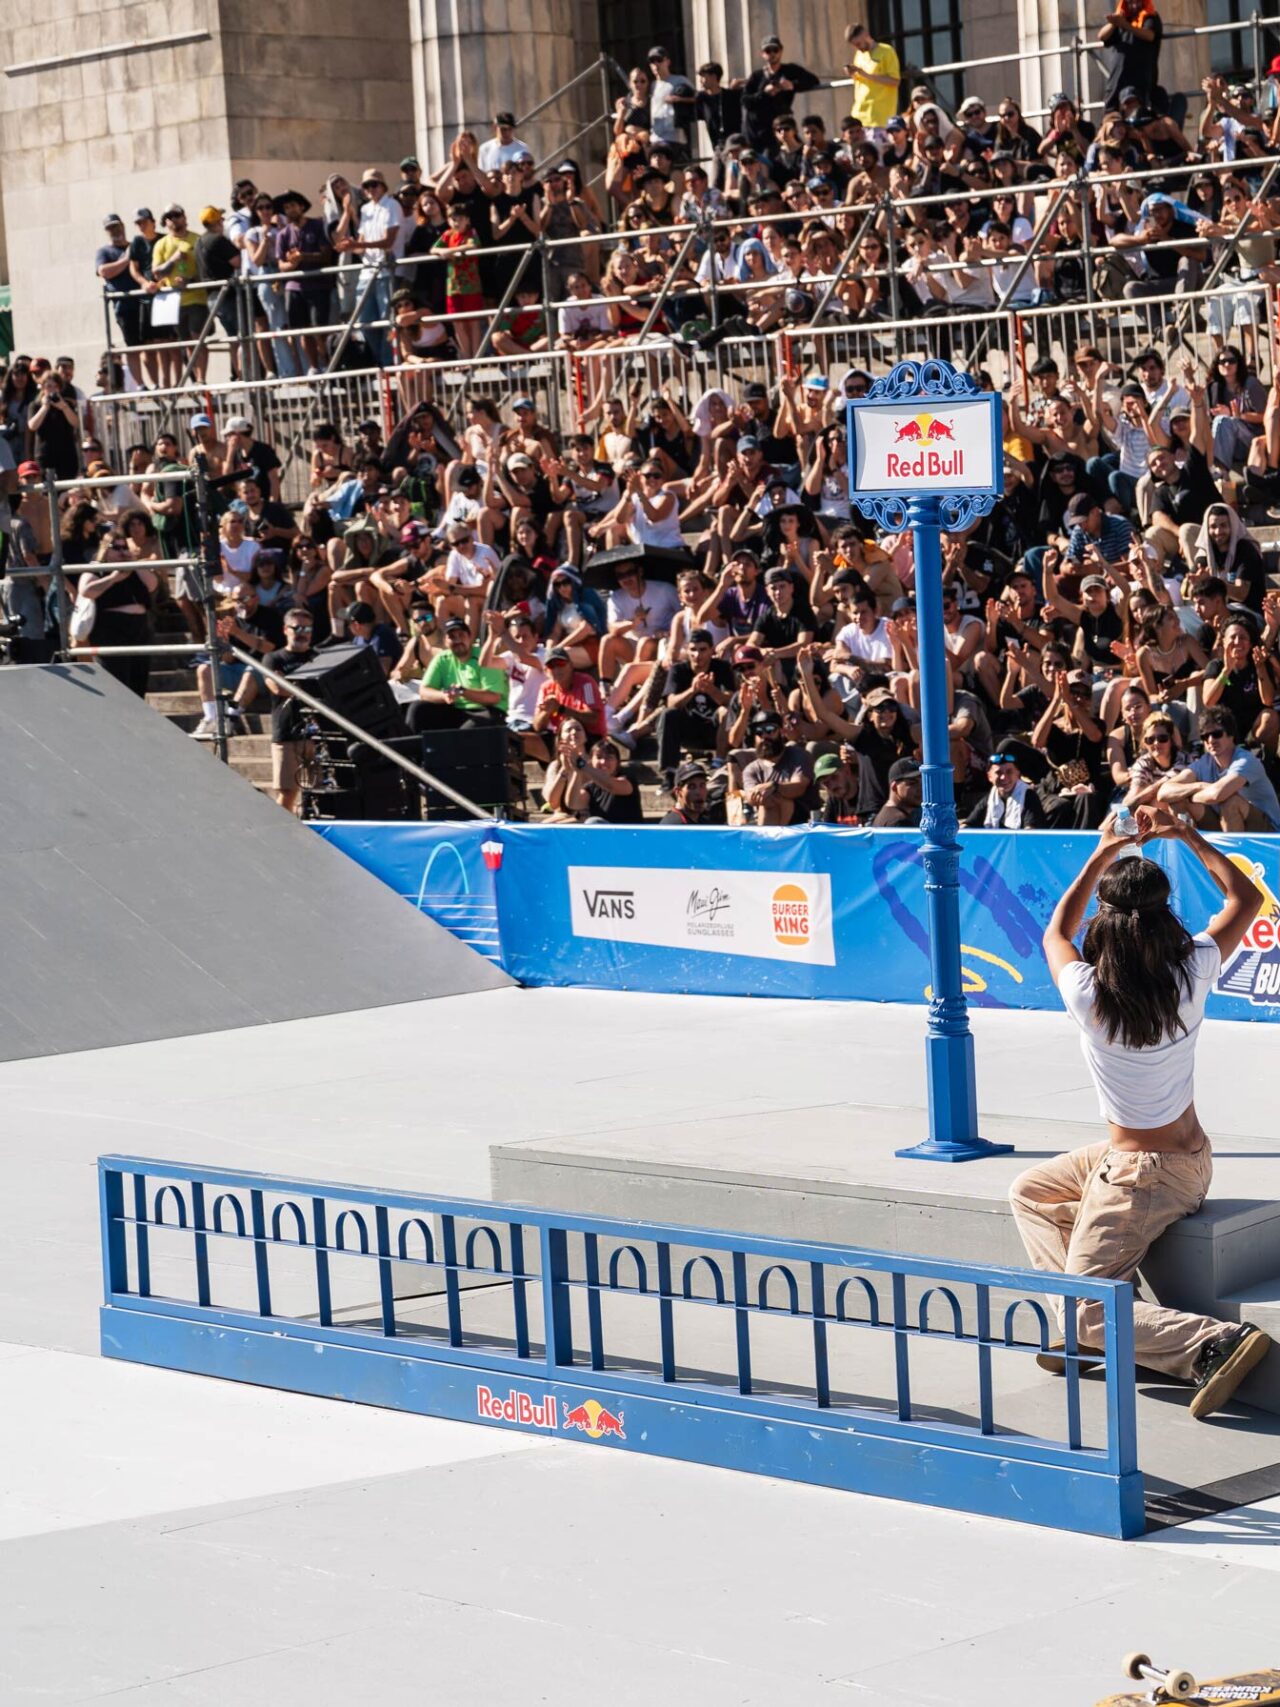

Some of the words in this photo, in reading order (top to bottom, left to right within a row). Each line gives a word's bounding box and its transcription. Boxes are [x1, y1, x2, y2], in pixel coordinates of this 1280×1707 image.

[887, 451, 925, 478] Red
[928, 449, 964, 476] Bull
[582, 889, 635, 919] VANS
[772, 903, 809, 916] BURGER
[773, 917, 809, 934] KING
[478, 1386, 516, 1421] Red
[518, 1393, 557, 1427] Bull
